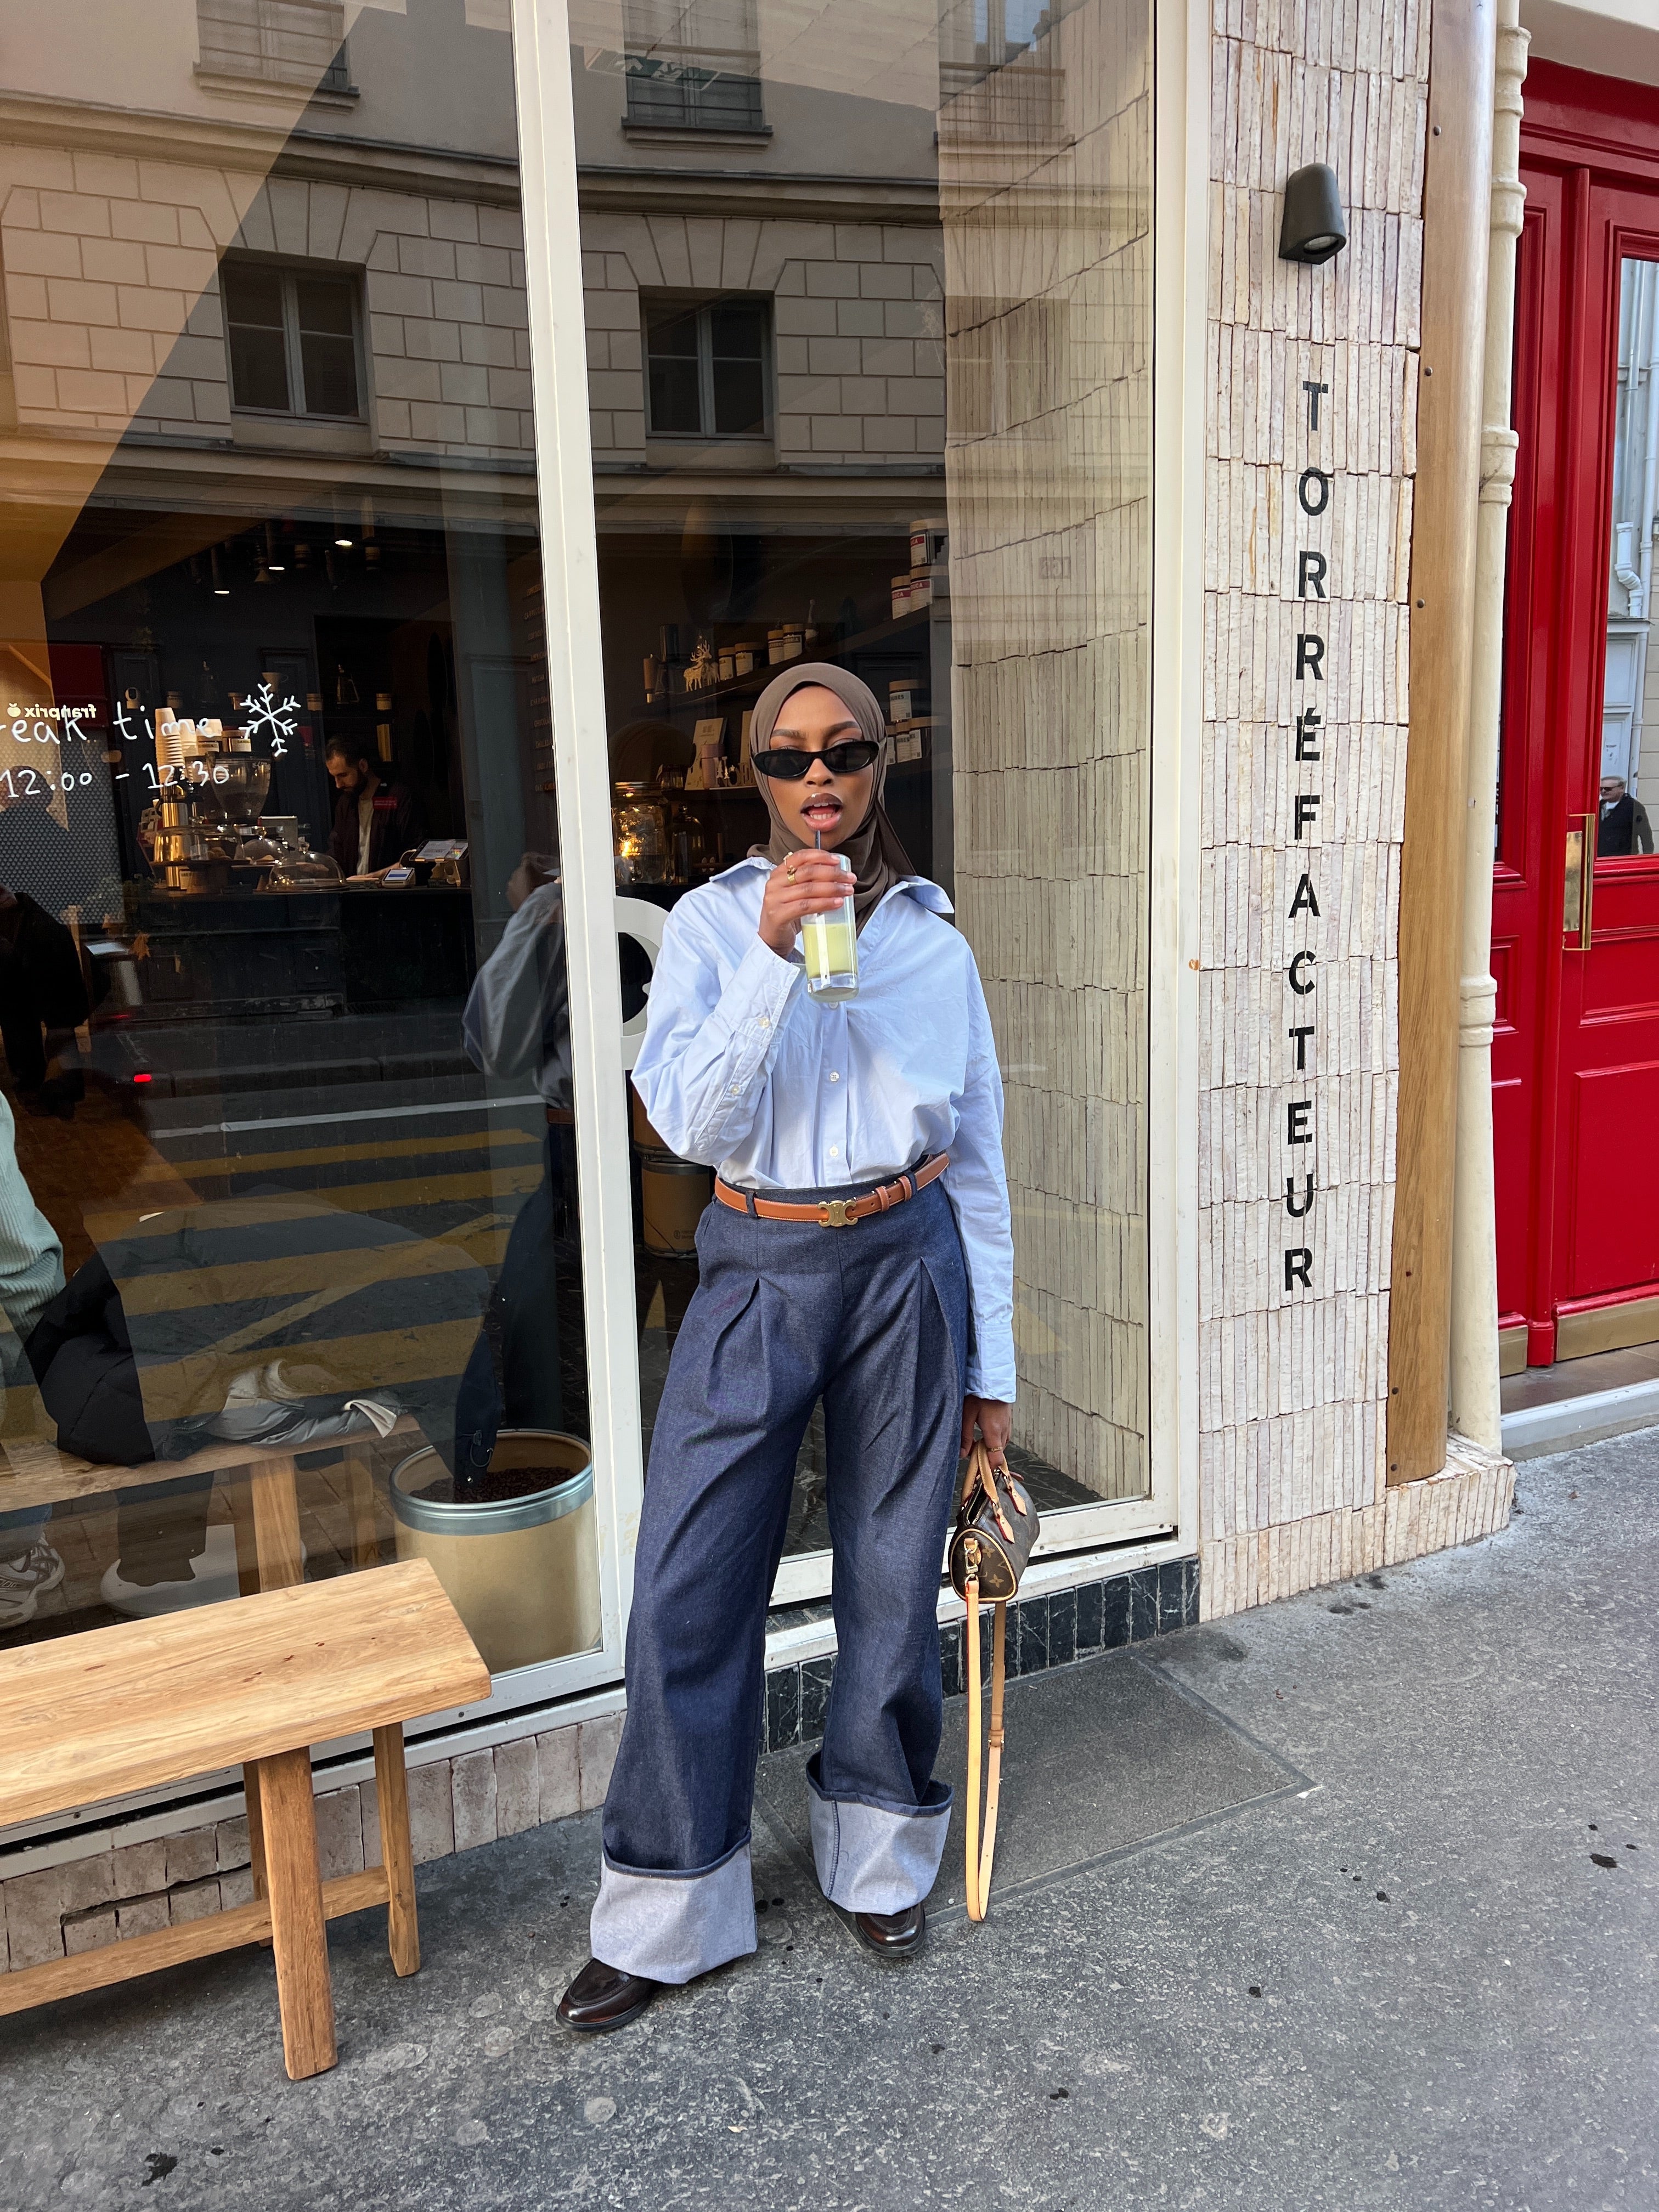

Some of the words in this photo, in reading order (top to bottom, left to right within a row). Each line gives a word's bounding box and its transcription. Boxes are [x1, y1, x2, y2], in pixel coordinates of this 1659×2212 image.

[113, 701, 217, 740] time
[0, 769, 93, 797] 12:00
[142, 763, 229, 789] 12:30
[1285, 380, 1329, 1291] TORRÉFACTEUR
